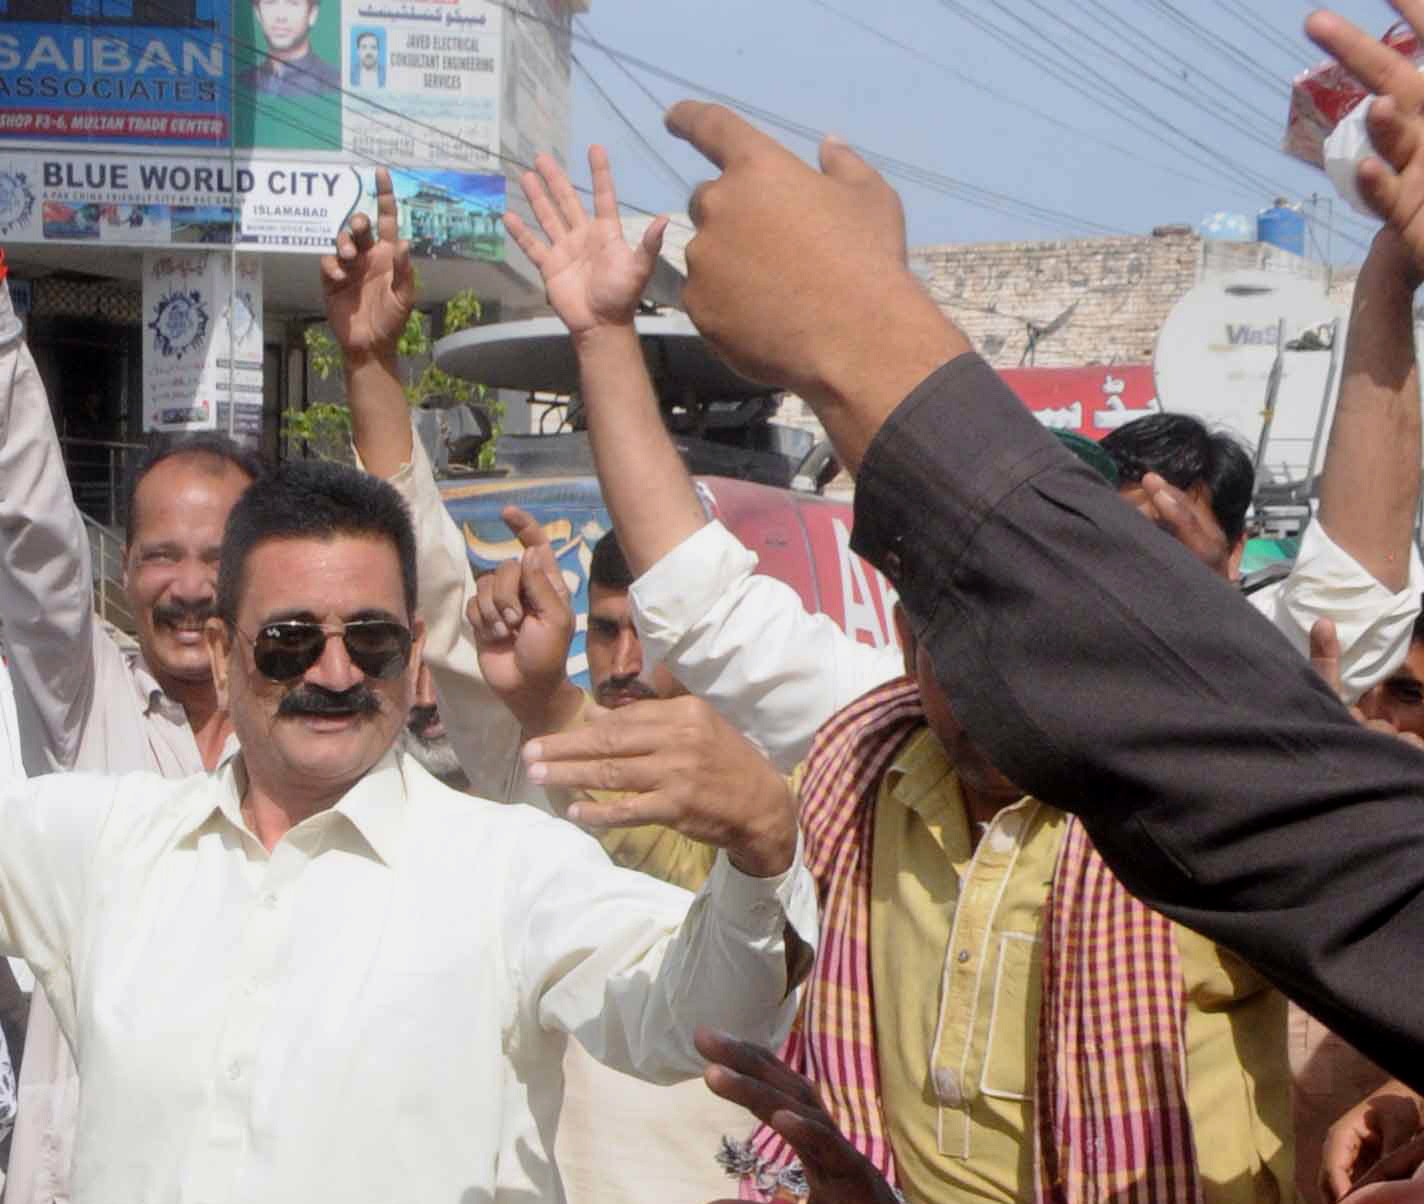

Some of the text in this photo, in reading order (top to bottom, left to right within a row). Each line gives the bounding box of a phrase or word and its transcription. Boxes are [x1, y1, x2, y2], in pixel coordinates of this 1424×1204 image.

[406, 32, 480, 53] JAVED ELECTRICAL
[391, 51, 495, 73] CONSULTANT ENGINEERING
[424, 72, 462, 89] SERVICES
[71, 115, 124, 131] MULTAN
[128, 117, 169, 133] TRADE
[170, 118, 225, 136] CENTER
[42, 161, 341, 198] BLUE WORLD CITY
[253, 205, 329, 217] ISLAMABAD
